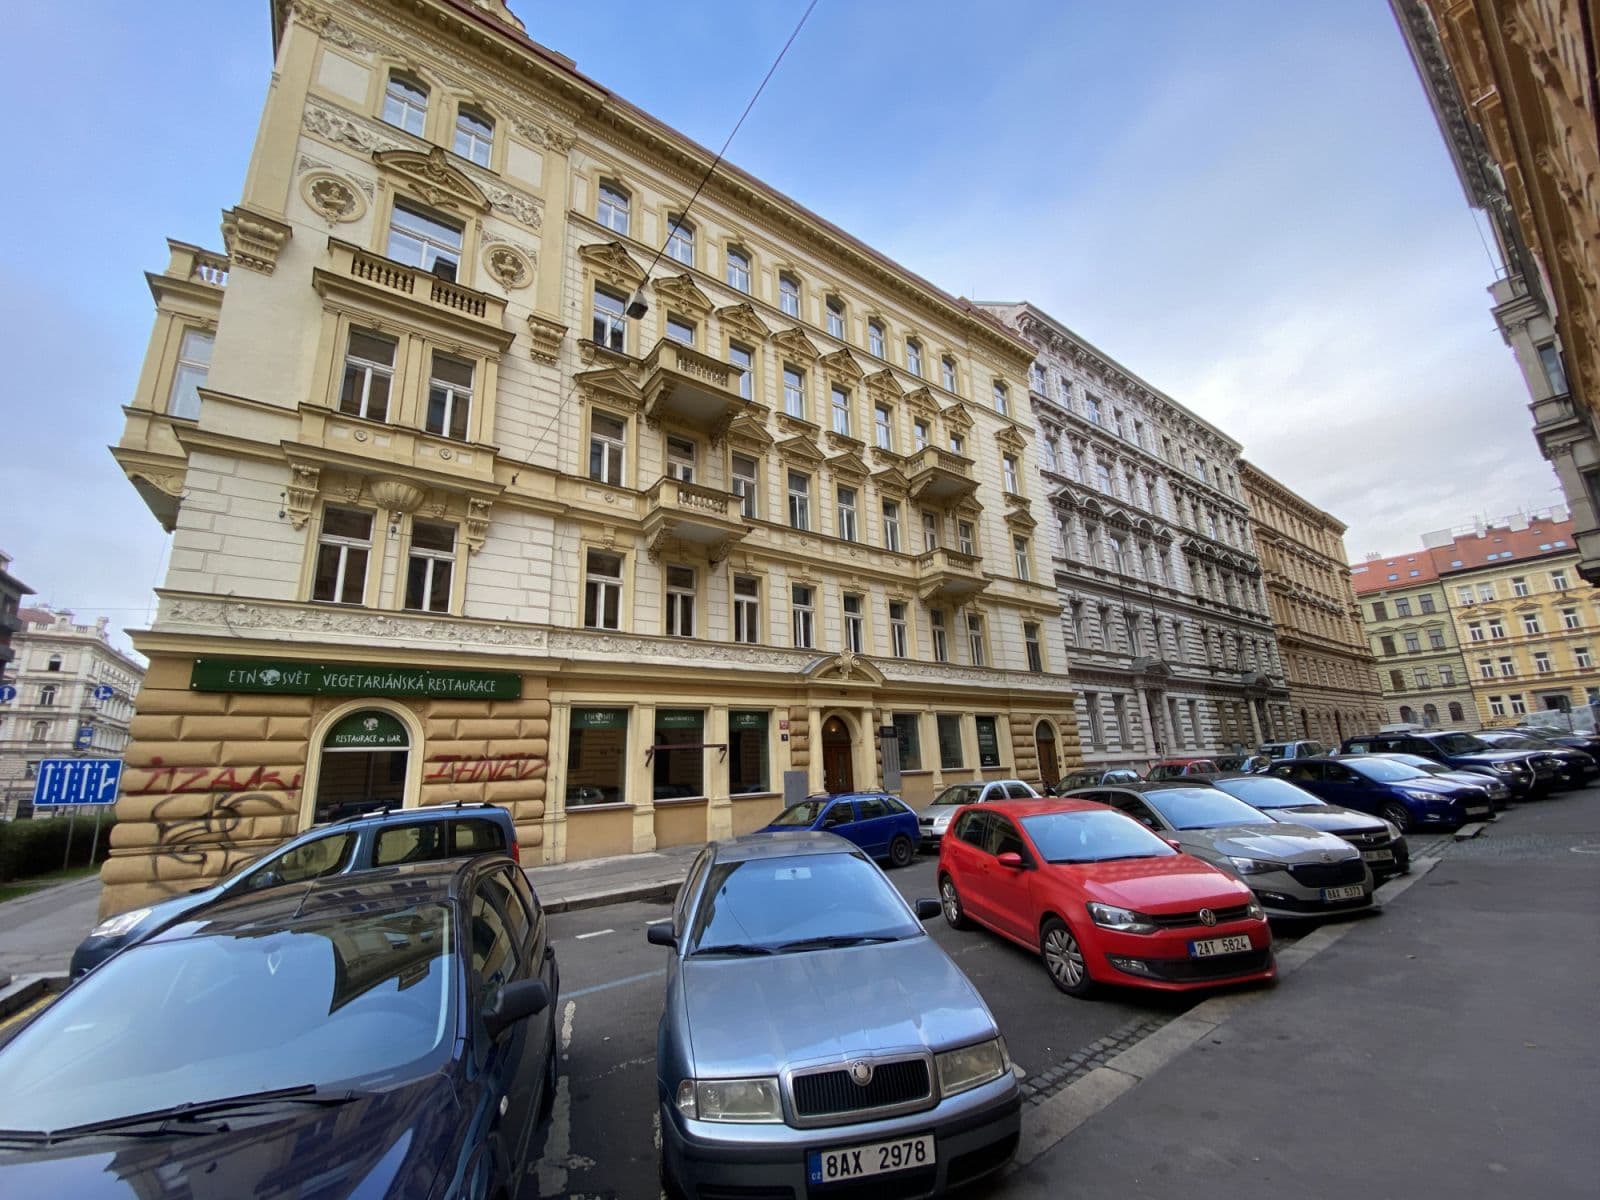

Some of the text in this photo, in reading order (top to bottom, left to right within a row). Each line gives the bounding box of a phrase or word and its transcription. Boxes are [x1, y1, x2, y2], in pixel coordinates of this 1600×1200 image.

[323, 673, 424, 690] VEGETARIÁNSKÁ
[428, 678, 496, 692] RESTAURACE
[335, 734, 377, 743] RESTAURACE
[1197, 938, 1247, 955] 2AT 5824
[827, 1150, 863, 1178] 8AX
[879, 1140, 926, 1170] 2978
